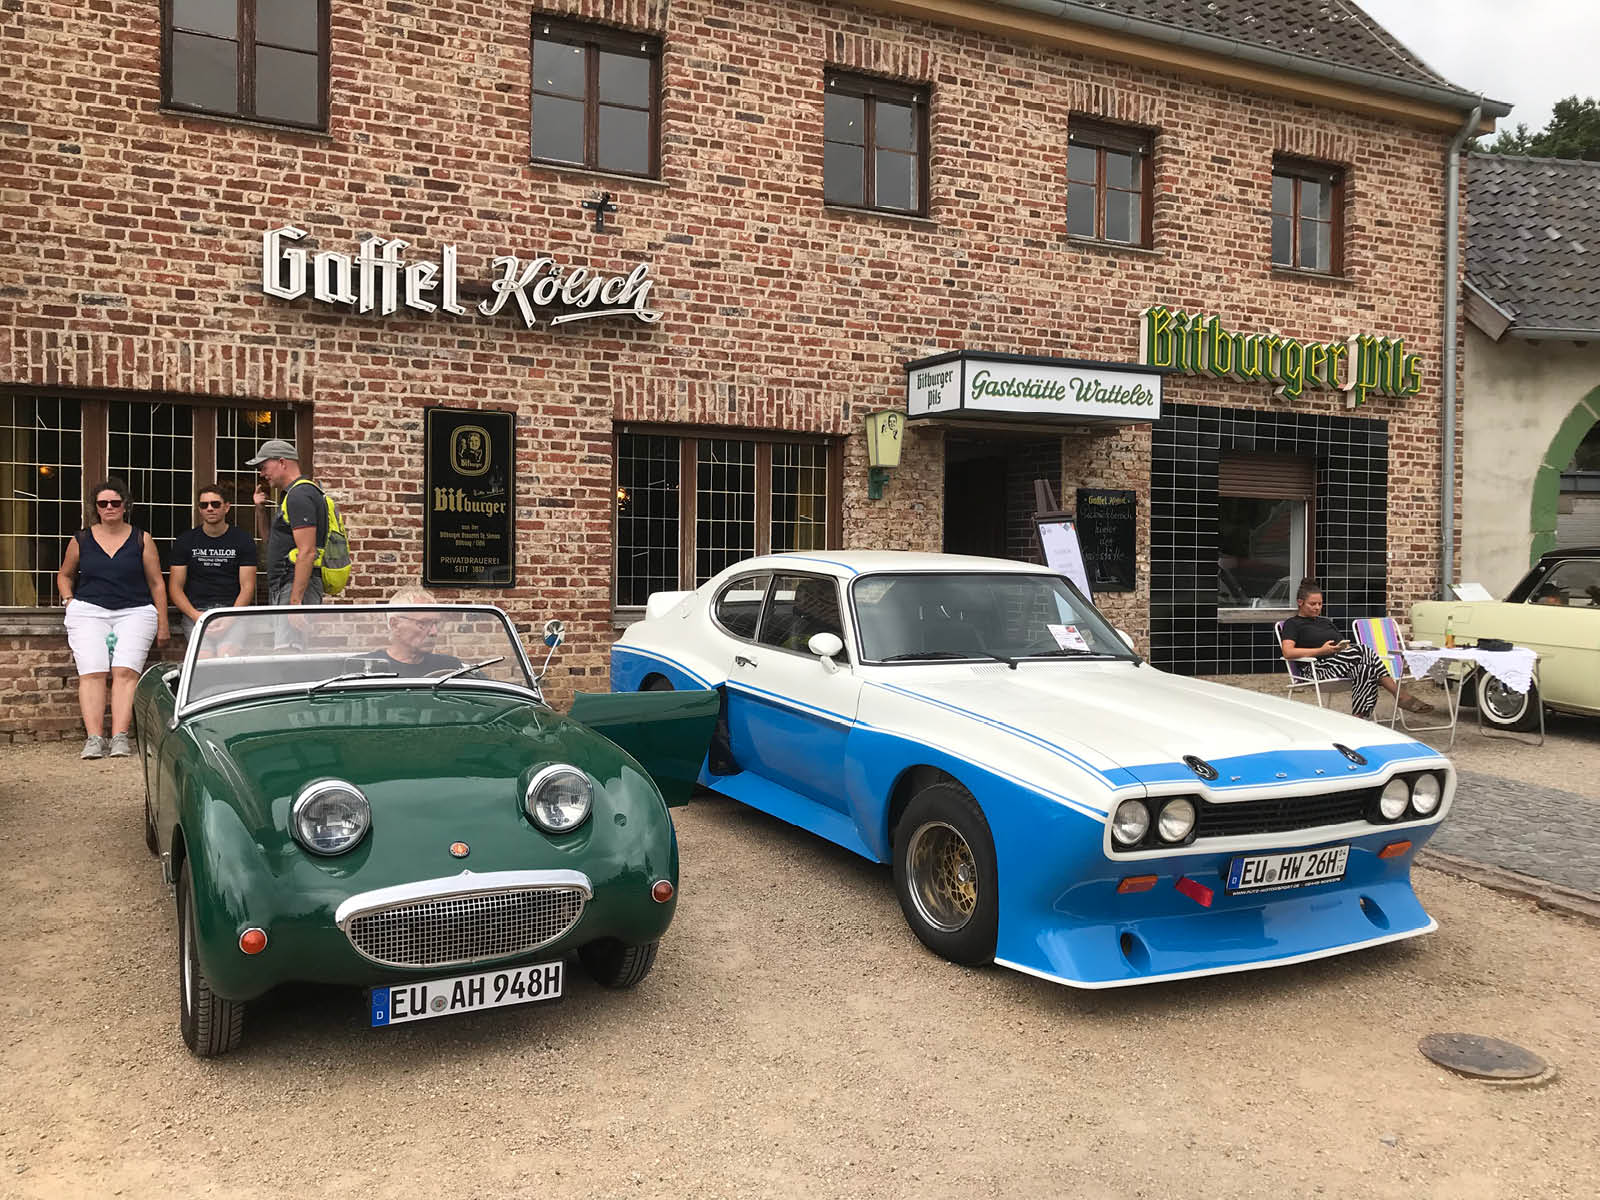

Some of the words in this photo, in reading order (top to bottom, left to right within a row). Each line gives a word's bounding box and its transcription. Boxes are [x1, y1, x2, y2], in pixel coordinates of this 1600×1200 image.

[263, 225, 466, 316] Gaffel
[478, 255, 664, 328] Kölsch
[1139, 305, 1348, 401] Bitburger
[1346, 333, 1423, 408] Pils
[917, 369, 954, 391] Bitburger
[971, 369, 1066, 401] Gaststätte
[1069, 376, 1155, 407] Watteler
[926, 389, 942, 409] Pils
[433, 487, 507, 518] Bitburger
[440, 556, 500, 565] PRIVATBRAUEREI
[1241, 860, 1268, 885] EU
[1277, 855, 1304, 881] HW
[1304, 850, 1339, 877] 26H
[376, 1011, 384, 1020] D
[391, 985, 428, 1019] EU
[450, 976, 485, 1009] AH
[494, 965, 560, 1003] 948H
